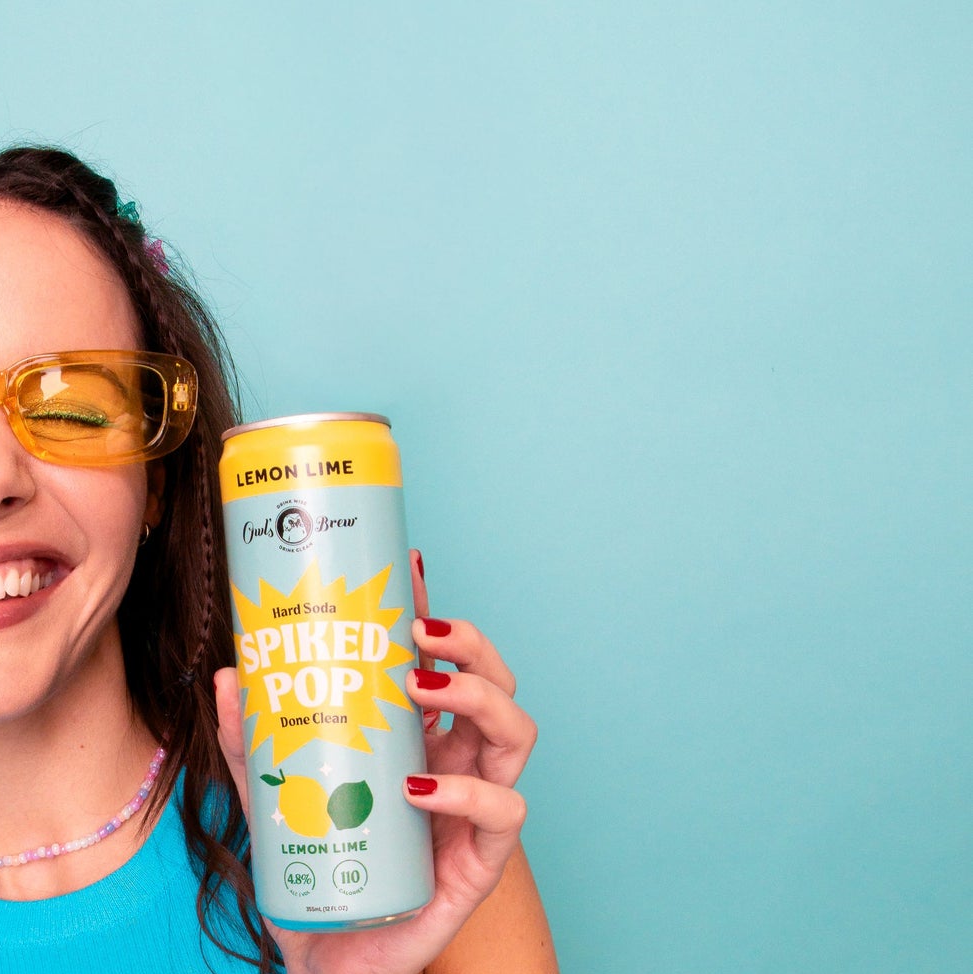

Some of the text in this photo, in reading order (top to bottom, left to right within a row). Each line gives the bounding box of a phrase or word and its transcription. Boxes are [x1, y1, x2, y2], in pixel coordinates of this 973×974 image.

[237, 460, 354, 487] LEMON LIME
[242, 515, 358, 544] Owl's Brew
[272, 602, 337, 619] Hard Soda
[240, 620, 390, 675] SPIKED
[263, 666, 364, 714] POP
[280, 712, 348, 728] Done Clean
[281, 840, 368, 855] LEMON LIME
[287, 873, 312, 885] 4.8%
[341, 869, 360, 884] 110
[338, 886, 364, 896] CALORIES
